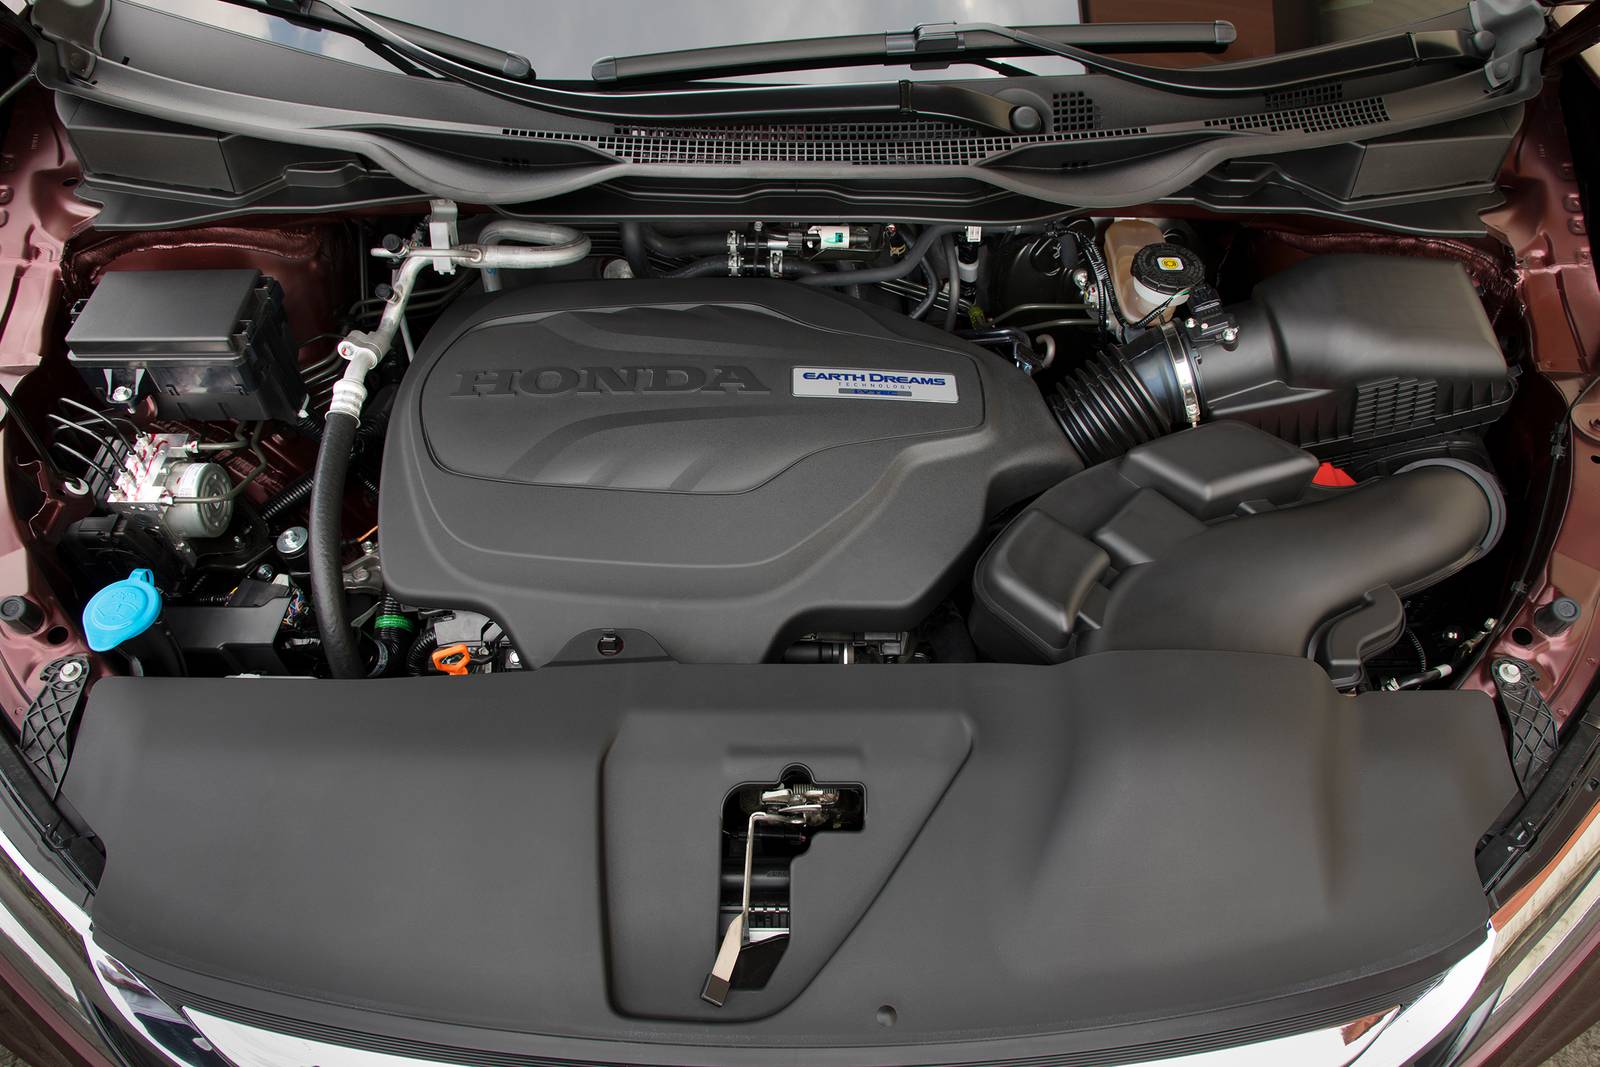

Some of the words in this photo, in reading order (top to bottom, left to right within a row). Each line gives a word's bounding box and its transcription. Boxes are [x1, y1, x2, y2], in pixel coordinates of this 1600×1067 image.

[451, 366, 771, 397] HONDA
[803, 372, 865, 382] EARTH
[869, 373, 946, 386] DREAMS
[838, 382, 912, 390] TECHNOLOGY
